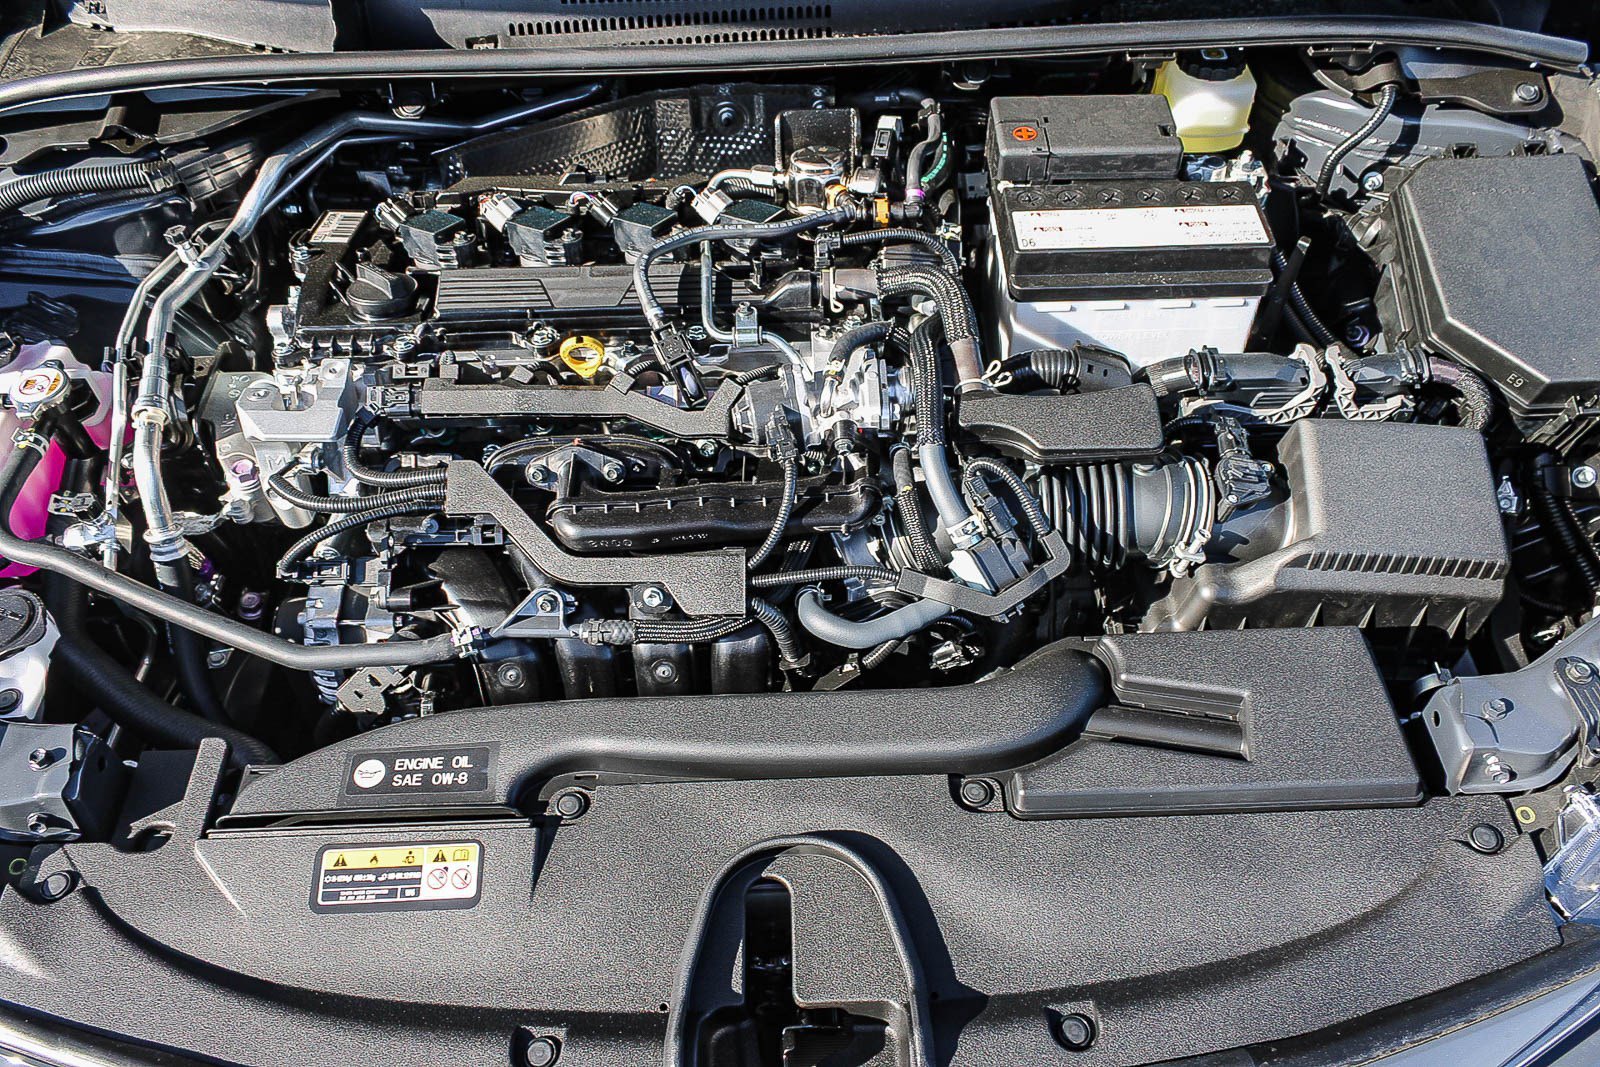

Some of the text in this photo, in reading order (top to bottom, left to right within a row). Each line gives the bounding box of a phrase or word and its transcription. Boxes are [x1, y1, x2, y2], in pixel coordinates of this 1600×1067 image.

[1021, 238, 1036, 247] D6
[1506, 373, 1524, 388] E9
[394, 756, 474, 771] ENGINE OIL
[392, 772, 468, 786] SAE 0W-8
